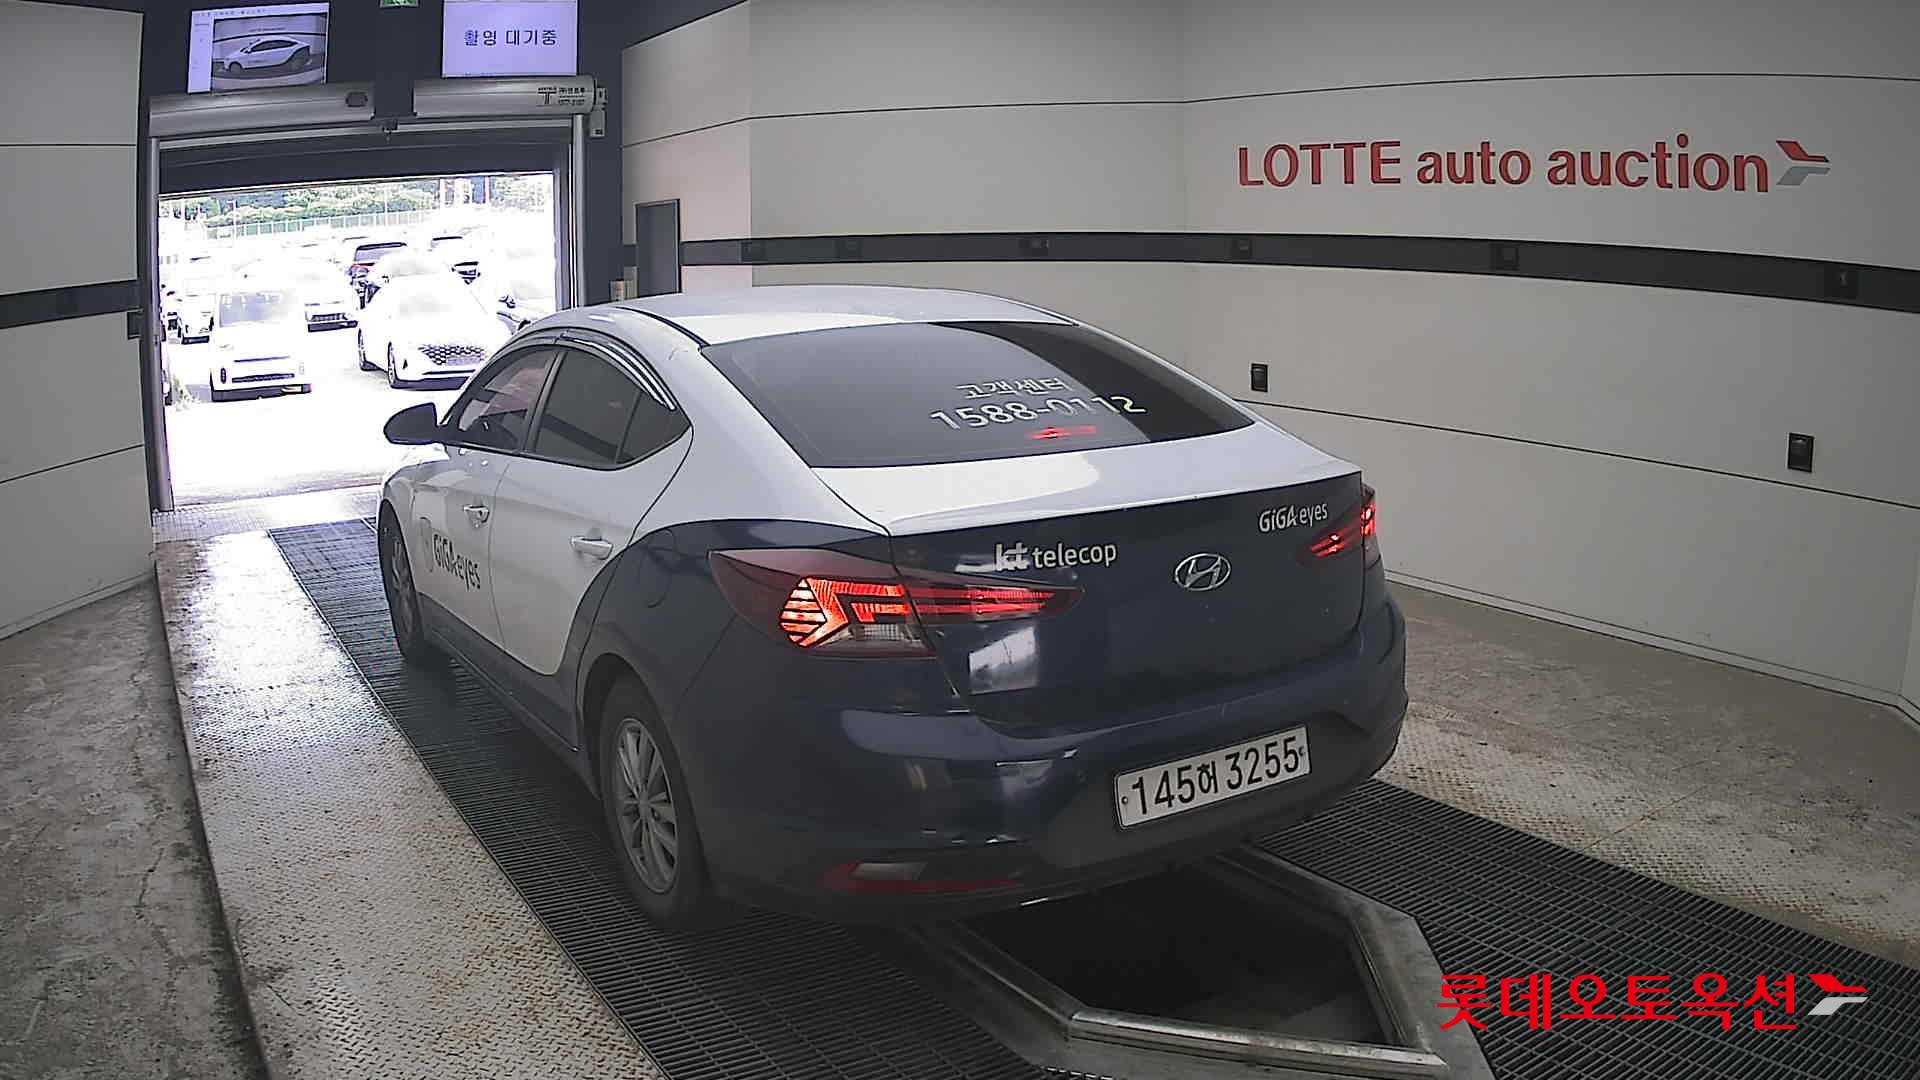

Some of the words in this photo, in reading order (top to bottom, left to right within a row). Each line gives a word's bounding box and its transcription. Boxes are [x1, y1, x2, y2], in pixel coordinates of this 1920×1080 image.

[505, 29, 558, 46] 대기중
[1238, 140, 1401, 187] LOTTE
[1416, 141, 1531, 185] auto
[1547, 133, 1769, 193] auction
[956, 376, 1073, 399] 고객센터
[930, 396, 1147, 430] 1588-0112
[995, 542, 1029, 572] kt
[1031, 542, 1117, 570] telecop
